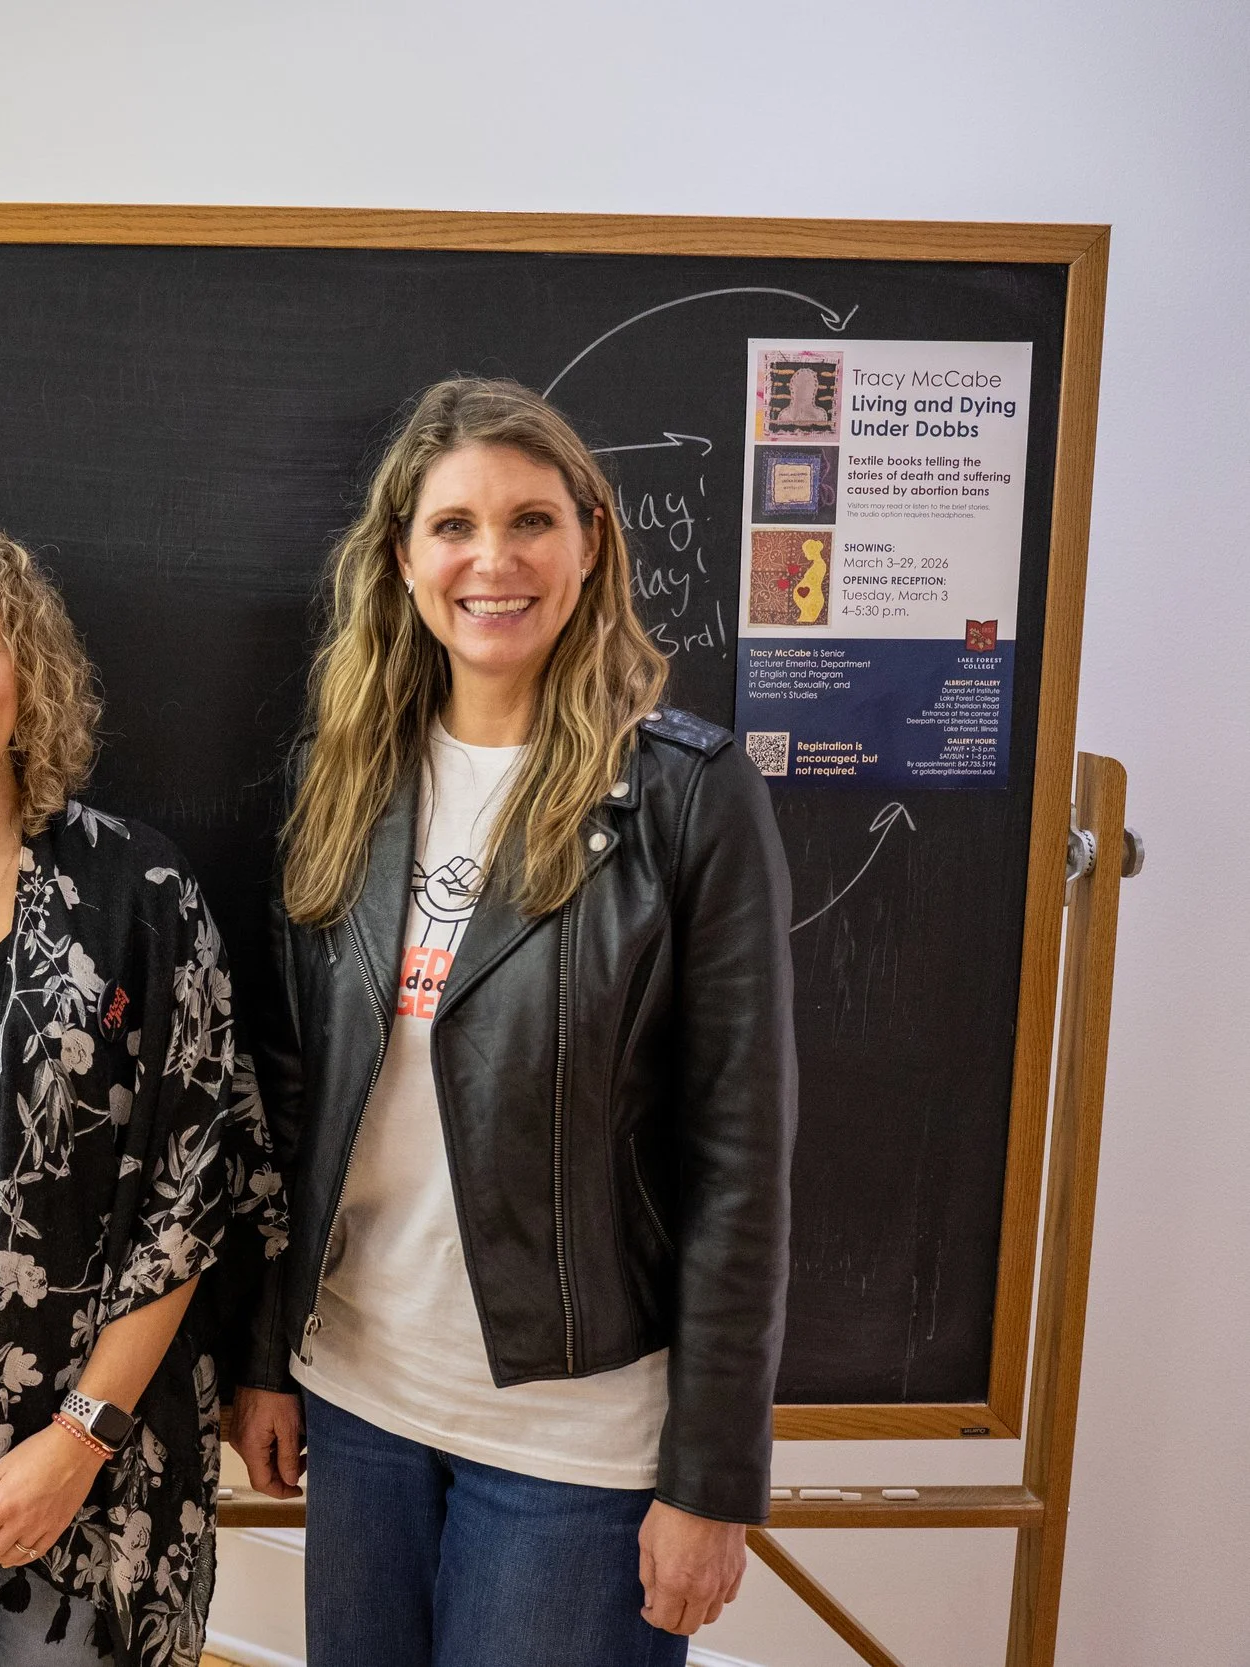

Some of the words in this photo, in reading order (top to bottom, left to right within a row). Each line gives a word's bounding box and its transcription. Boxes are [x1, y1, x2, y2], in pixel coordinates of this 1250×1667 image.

[853, 369, 904, 389] Tracy
[912, 370, 1001, 388] McCabe
[852, 396, 906, 415] Living
[914, 397, 952, 412] and
[960, 398, 1016, 417] Dying
[851, 420, 909, 436] Under
[916, 420, 978, 438] Dobbs
[848, 456, 883, 466] Textile
[888, 456, 922, 466] books
[925, 457, 959, 468] telling
[963, 457, 981, 466] the
[848, 470, 882, 480] stories
[886, 470, 897, 481] of
[900, 471, 934, 481] death
[938, 472, 960, 481] and
[963, 472, 1010, 484] suffering
[847, 485, 889, 495] caused
[893, 486, 906, 497] by
[910, 486, 958, 496] abortion
[962, 486, 989, 496] bans
[844, 544, 895, 552] SHOWING:
[844, 558, 883, 568] March
[922, 559, 948, 569] 2026
[843, 576, 888, 585] OPENING
[891, 577, 946, 586] RECEPTION:
[842, 590, 894, 602] Tuesday,
[898, 591, 937, 601] March
[942, 591, 948, 601] 3
[883, 608, 909, 618] p.m.
[750, 649, 772, 658] Tracy
[760, 670, 787, 679] English
[809, 671, 843, 679] Program
[758, 681, 791, 689] Gender,
[794, 681, 831, 690] Sexuality,
[797, 742, 853, 752] Registration
[855, 742, 862, 750] is
[796, 754, 859, 764] encouraged,
[862, 754, 878, 763] but
[813, 767, 856, 776] required.
